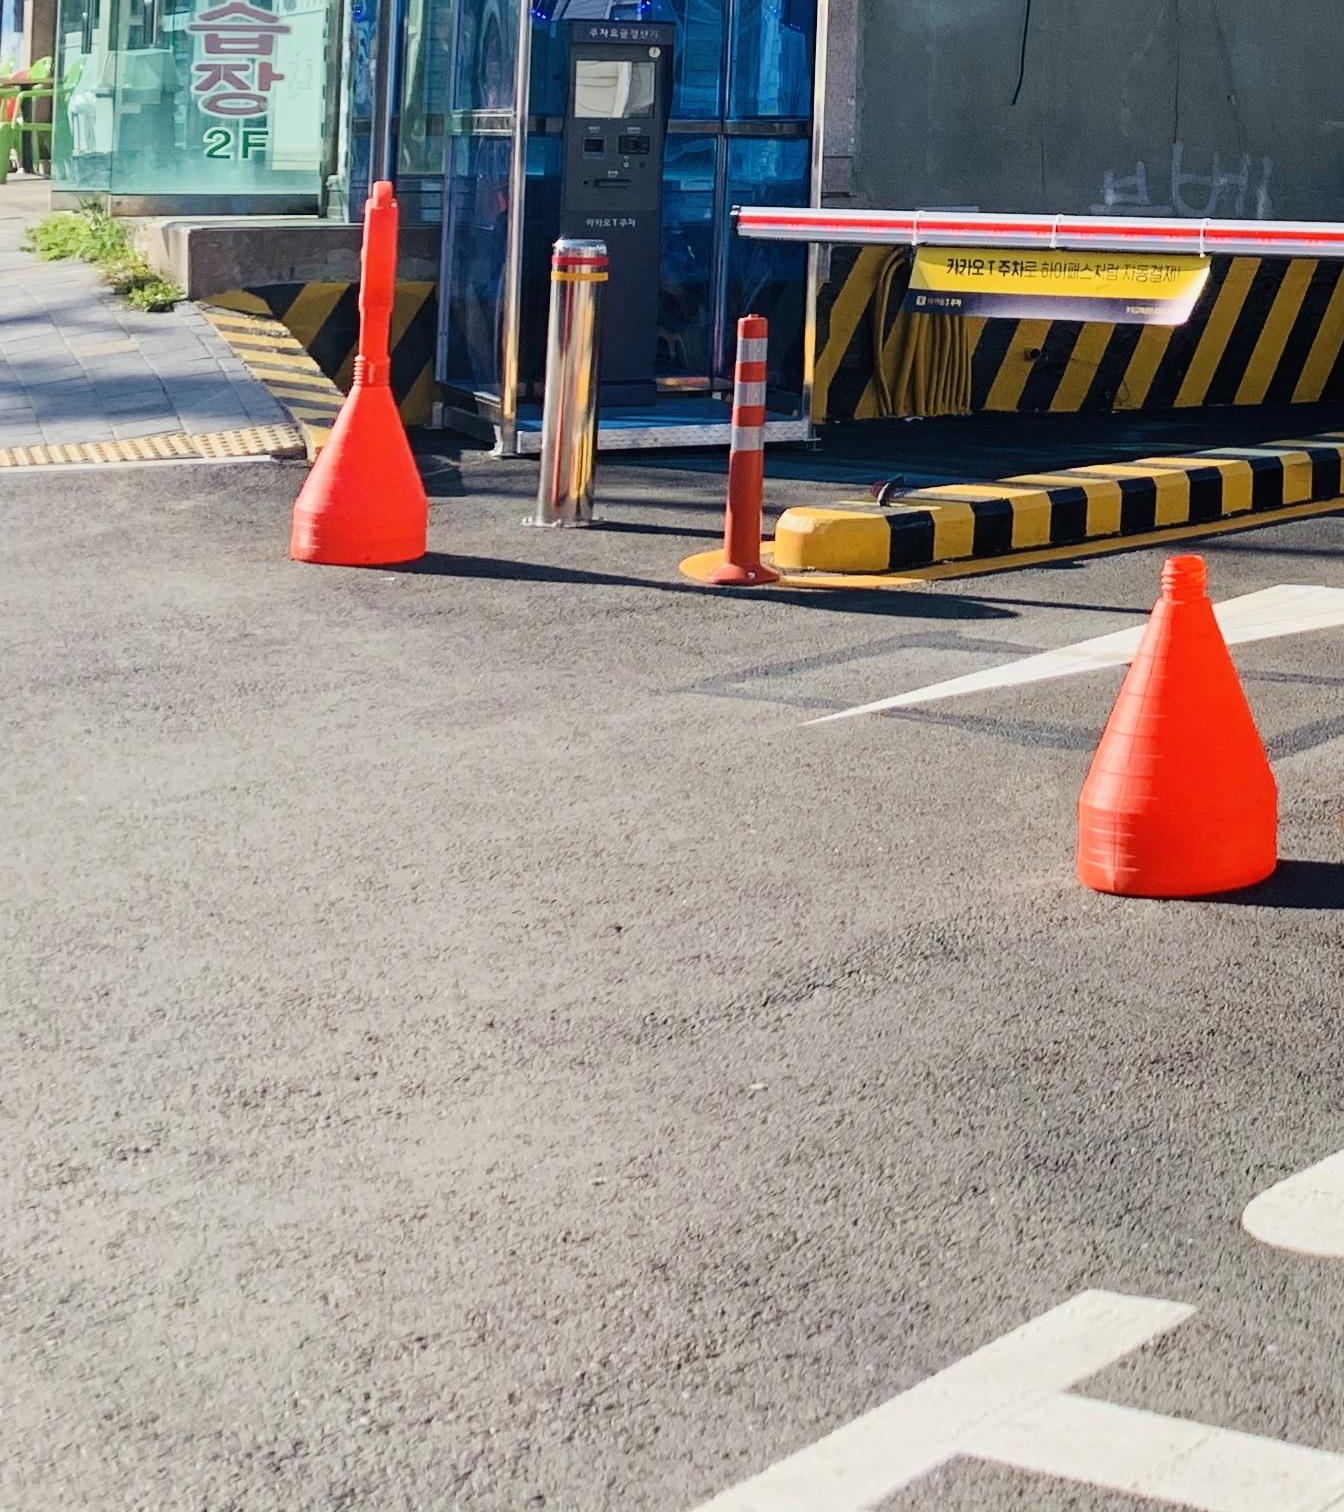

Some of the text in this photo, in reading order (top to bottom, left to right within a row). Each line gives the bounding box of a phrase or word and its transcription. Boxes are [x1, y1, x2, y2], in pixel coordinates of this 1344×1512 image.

[206, 129, 269, 159] 2F
[946, 258, 984, 276] 카카오
[998, 260, 1037, 278] 주차로
[1041, 263, 1118, 281] 하이패스처럼
